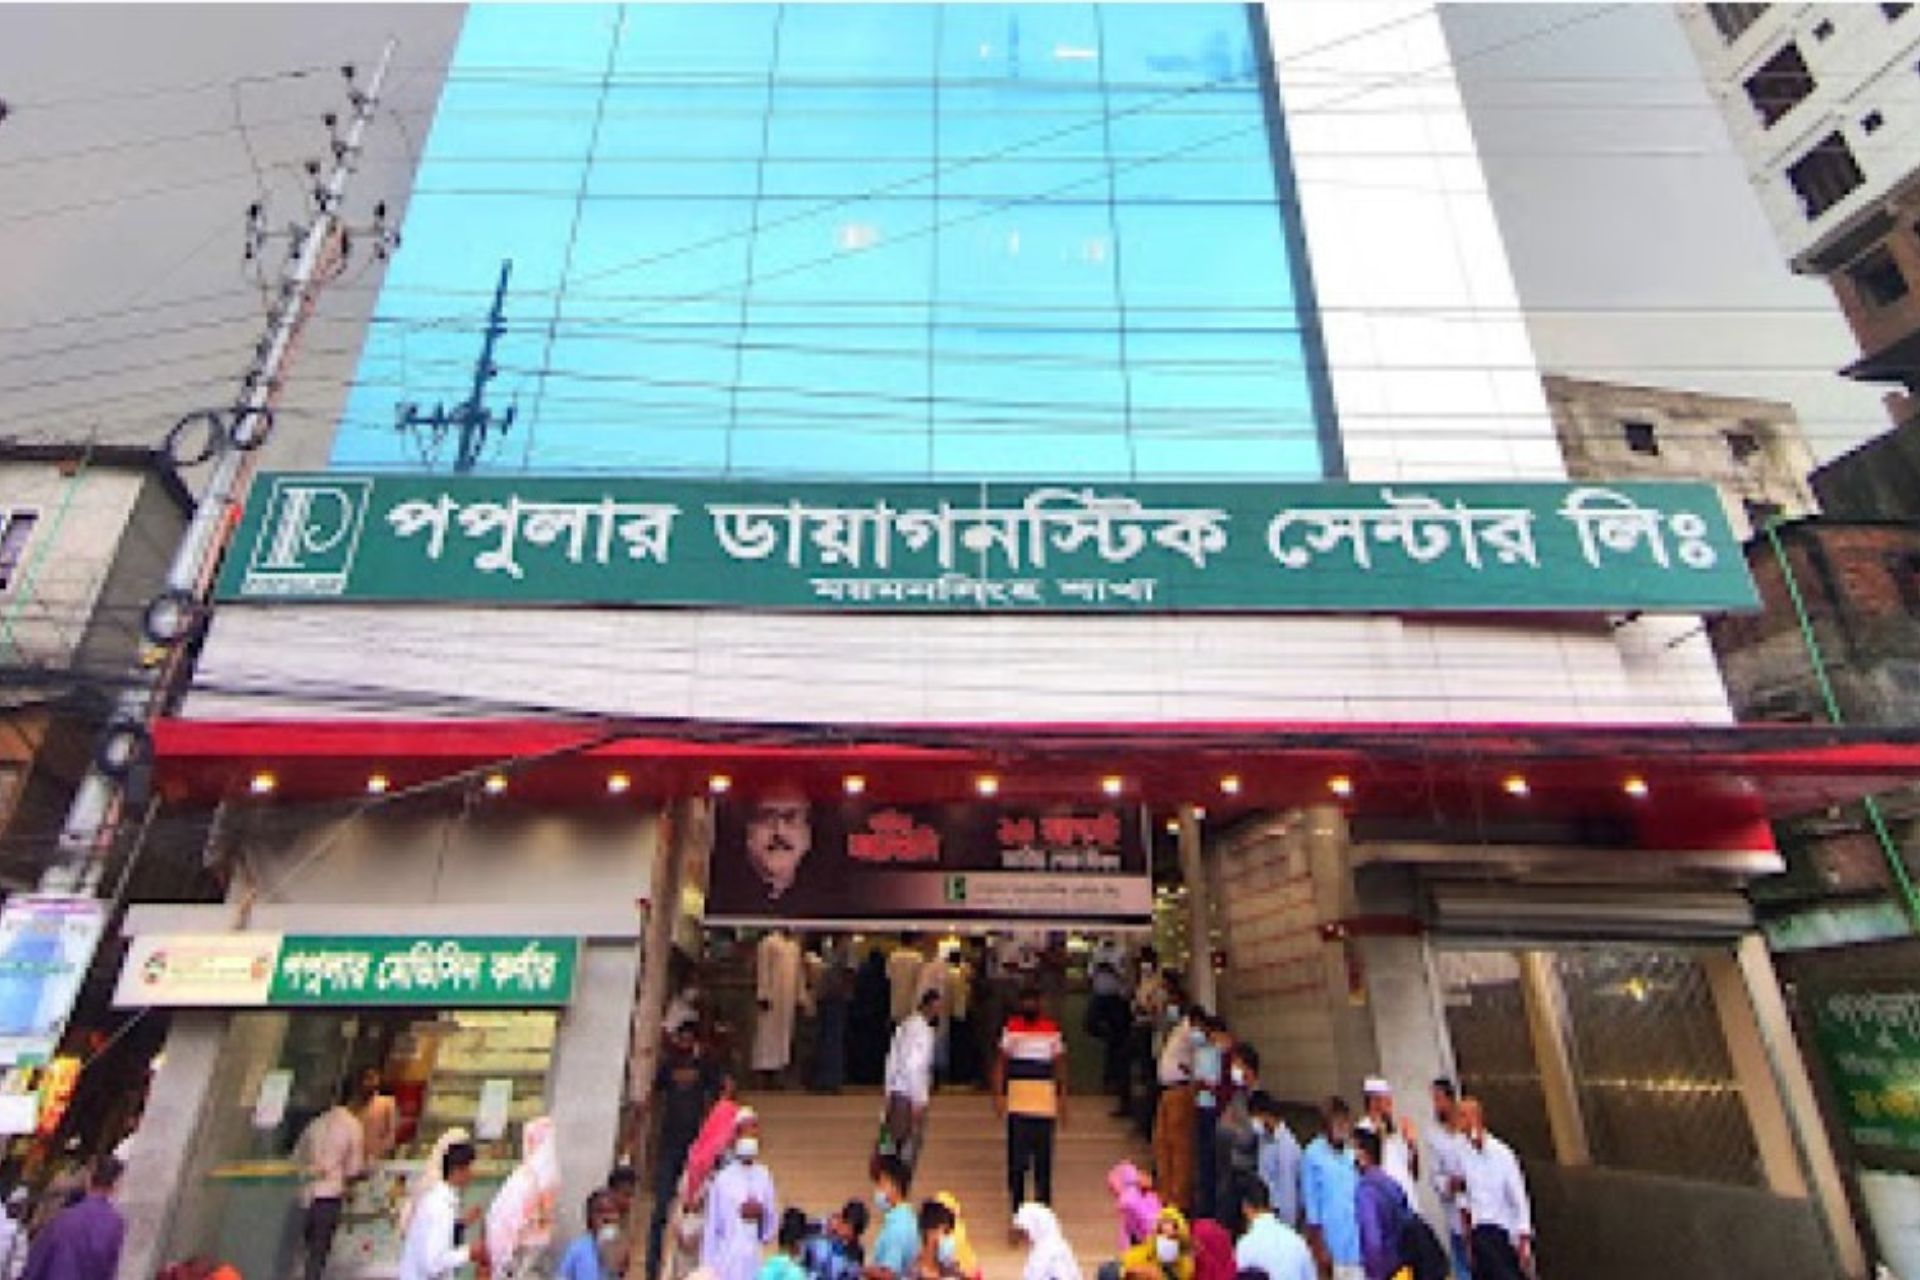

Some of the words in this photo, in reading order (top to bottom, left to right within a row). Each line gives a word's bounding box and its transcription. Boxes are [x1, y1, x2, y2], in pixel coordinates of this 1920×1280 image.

[386, 494, 681, 579] পপুলার
[704, 487, 1229, 570] ডায়াগনস্টিক
[1265, 487, 1539, 569] সেন্টার
[1557, 486, 1718, 569] লিঃ
